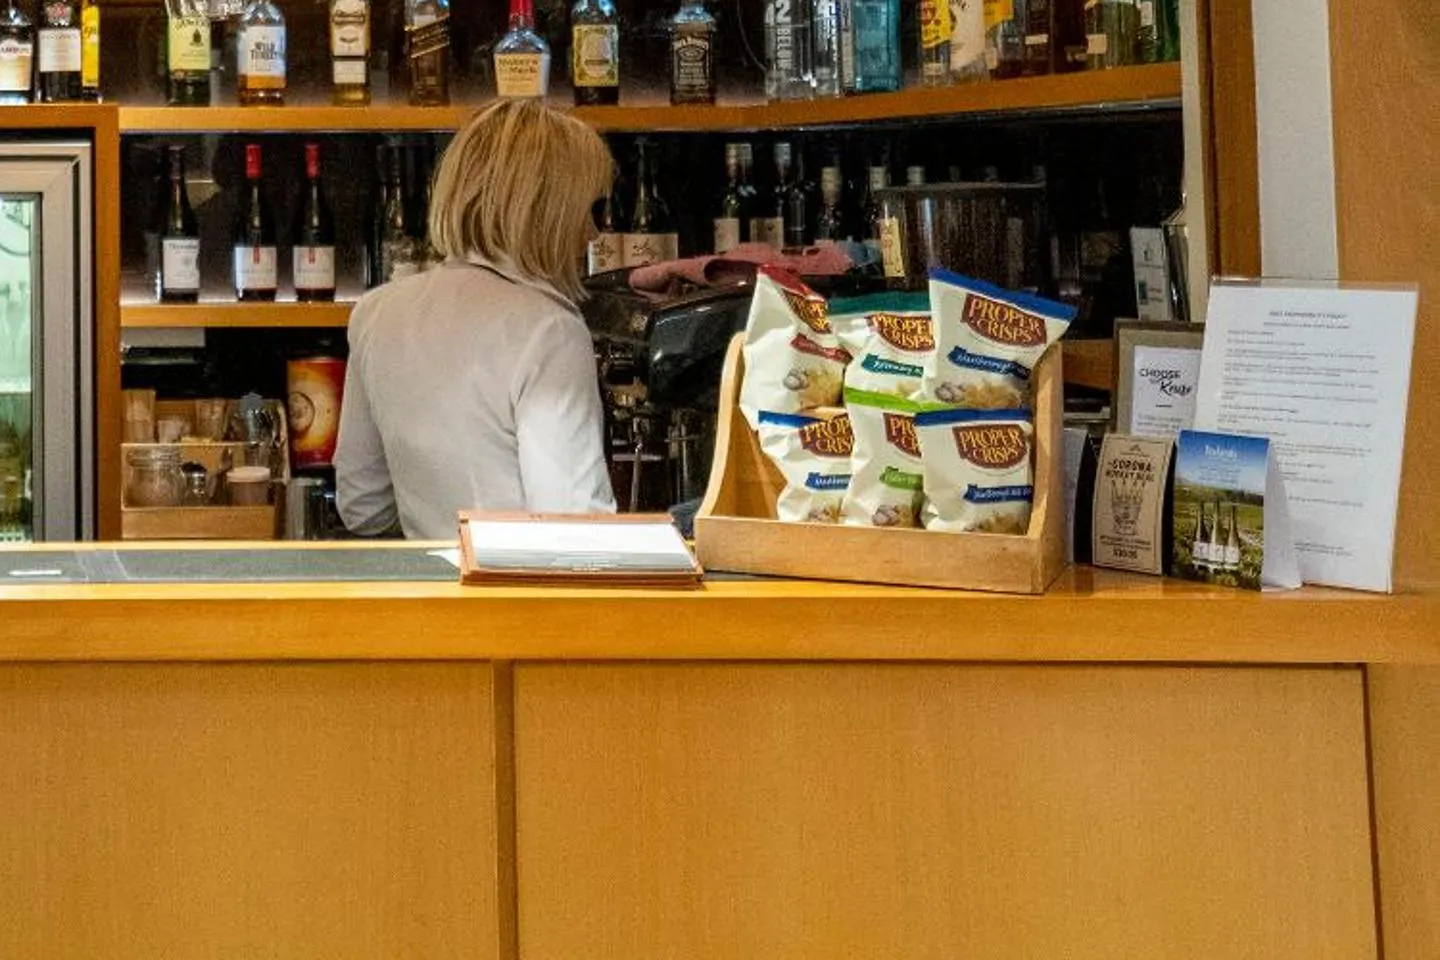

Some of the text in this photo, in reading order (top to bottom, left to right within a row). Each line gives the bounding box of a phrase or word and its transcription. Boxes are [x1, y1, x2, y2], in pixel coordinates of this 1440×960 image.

[968, 298, 1042, 337] PROPER
[976, 319, 1032, 342] CRISPS
[803, 417, 851, 442] PROP
[960, 427, 1024, 452] PROPER
[815, 439, 852, 454] CRIS
[972, 446, 1018, 464] CRISPS
